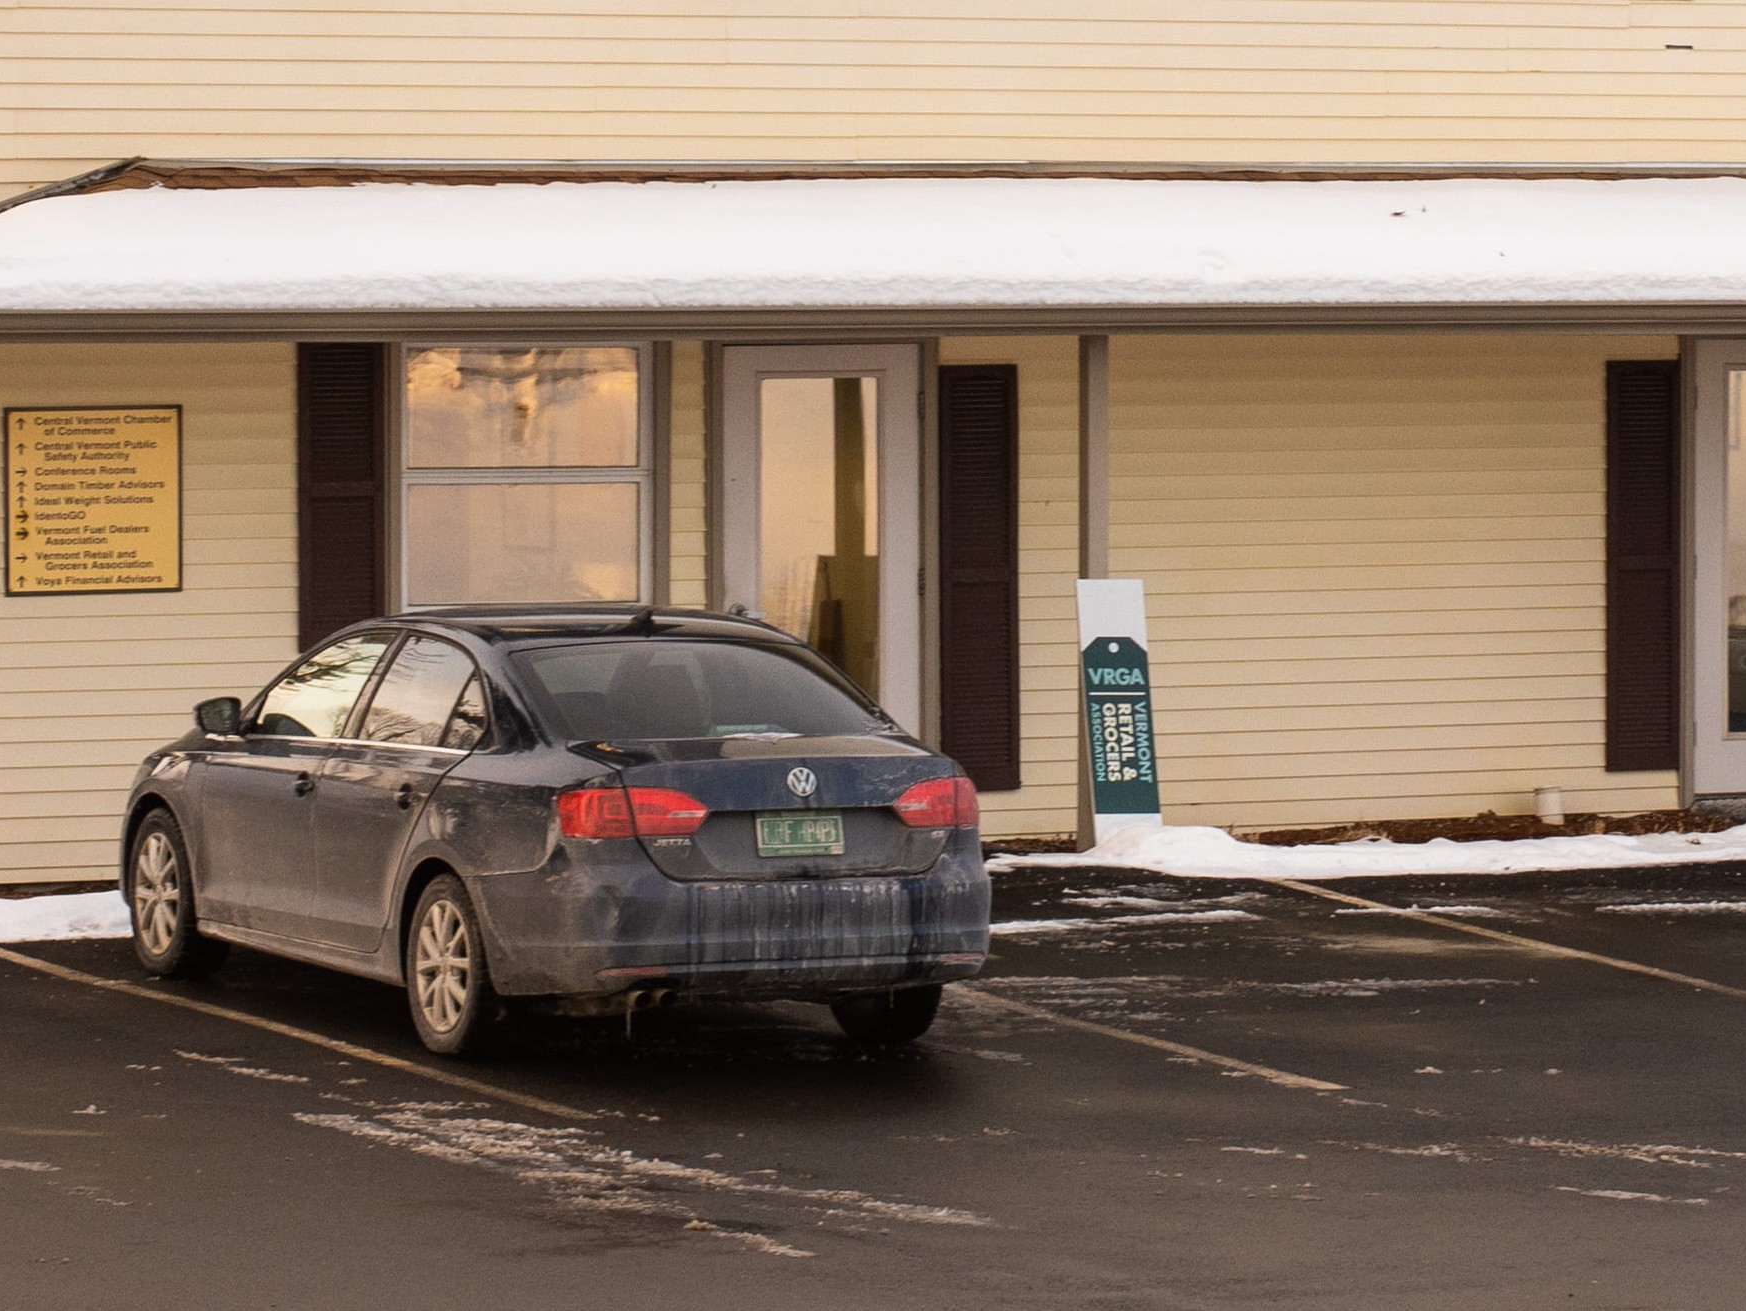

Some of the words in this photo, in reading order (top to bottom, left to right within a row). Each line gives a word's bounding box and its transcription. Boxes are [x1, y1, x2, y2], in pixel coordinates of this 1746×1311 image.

[34, 416, 73, 426] Central
[76, 415, 121, 425] Vermont
[123, 414, 172, 424] Chamber
[43, 427, 55, 436] of
[57, 426, 116, 436] Commerce
[34, 441, 73, 451] Central
[76, 441, 121, 450] Vermont
[123, 440, 157, 449] Public
[44, 452, 77, 462] Safety
[80, 451, 130, 461] Authority
[34, 467, 96, 476] Conference
[99, 465, 137, 475] Rooms
[34, 482, 75, 491] Domain
[78, 481, 115, 490] Timber
[117, 480, 165, 489] Advisors
[34, 496, 61, 506] Ideal
[63, 496, 101, 507] Weight
[103, 495, 154, 504] Solutions
[34, 510, 87, 520] IdentoGO
[35, 526, 81, 535] Vermont
[83, 525, 106, 534] Fuel
[108, 525, 149, 534] Dealers
[45, 536, 109, 546] Association
[35, 551, 81, 560] Vermont
[83, 550, 114, 560] Retail
[116, 550, 137, 559] and
[45, 561, 88, 571] Grocers
[90, 560, 154, 570] Association
[35, 576, 62, 587] Voya
[65, 576, 114, 585] Financial
[116, 574, 163, 584] Advisors
[1087, 667, 1146, 686] VRGA
[1117, 703, 1136, 762] RETAIL
[1090, 702, 1107, 782] ASSOCIATION
[1102, 702, 1122, 782] GROCERS
[1134, 701, 1153, 784] VERMONT
[1122, 766, 1138, 781] &
[787, 767, 818, 797] VW
[653, 838, 693, 847] JETTA
